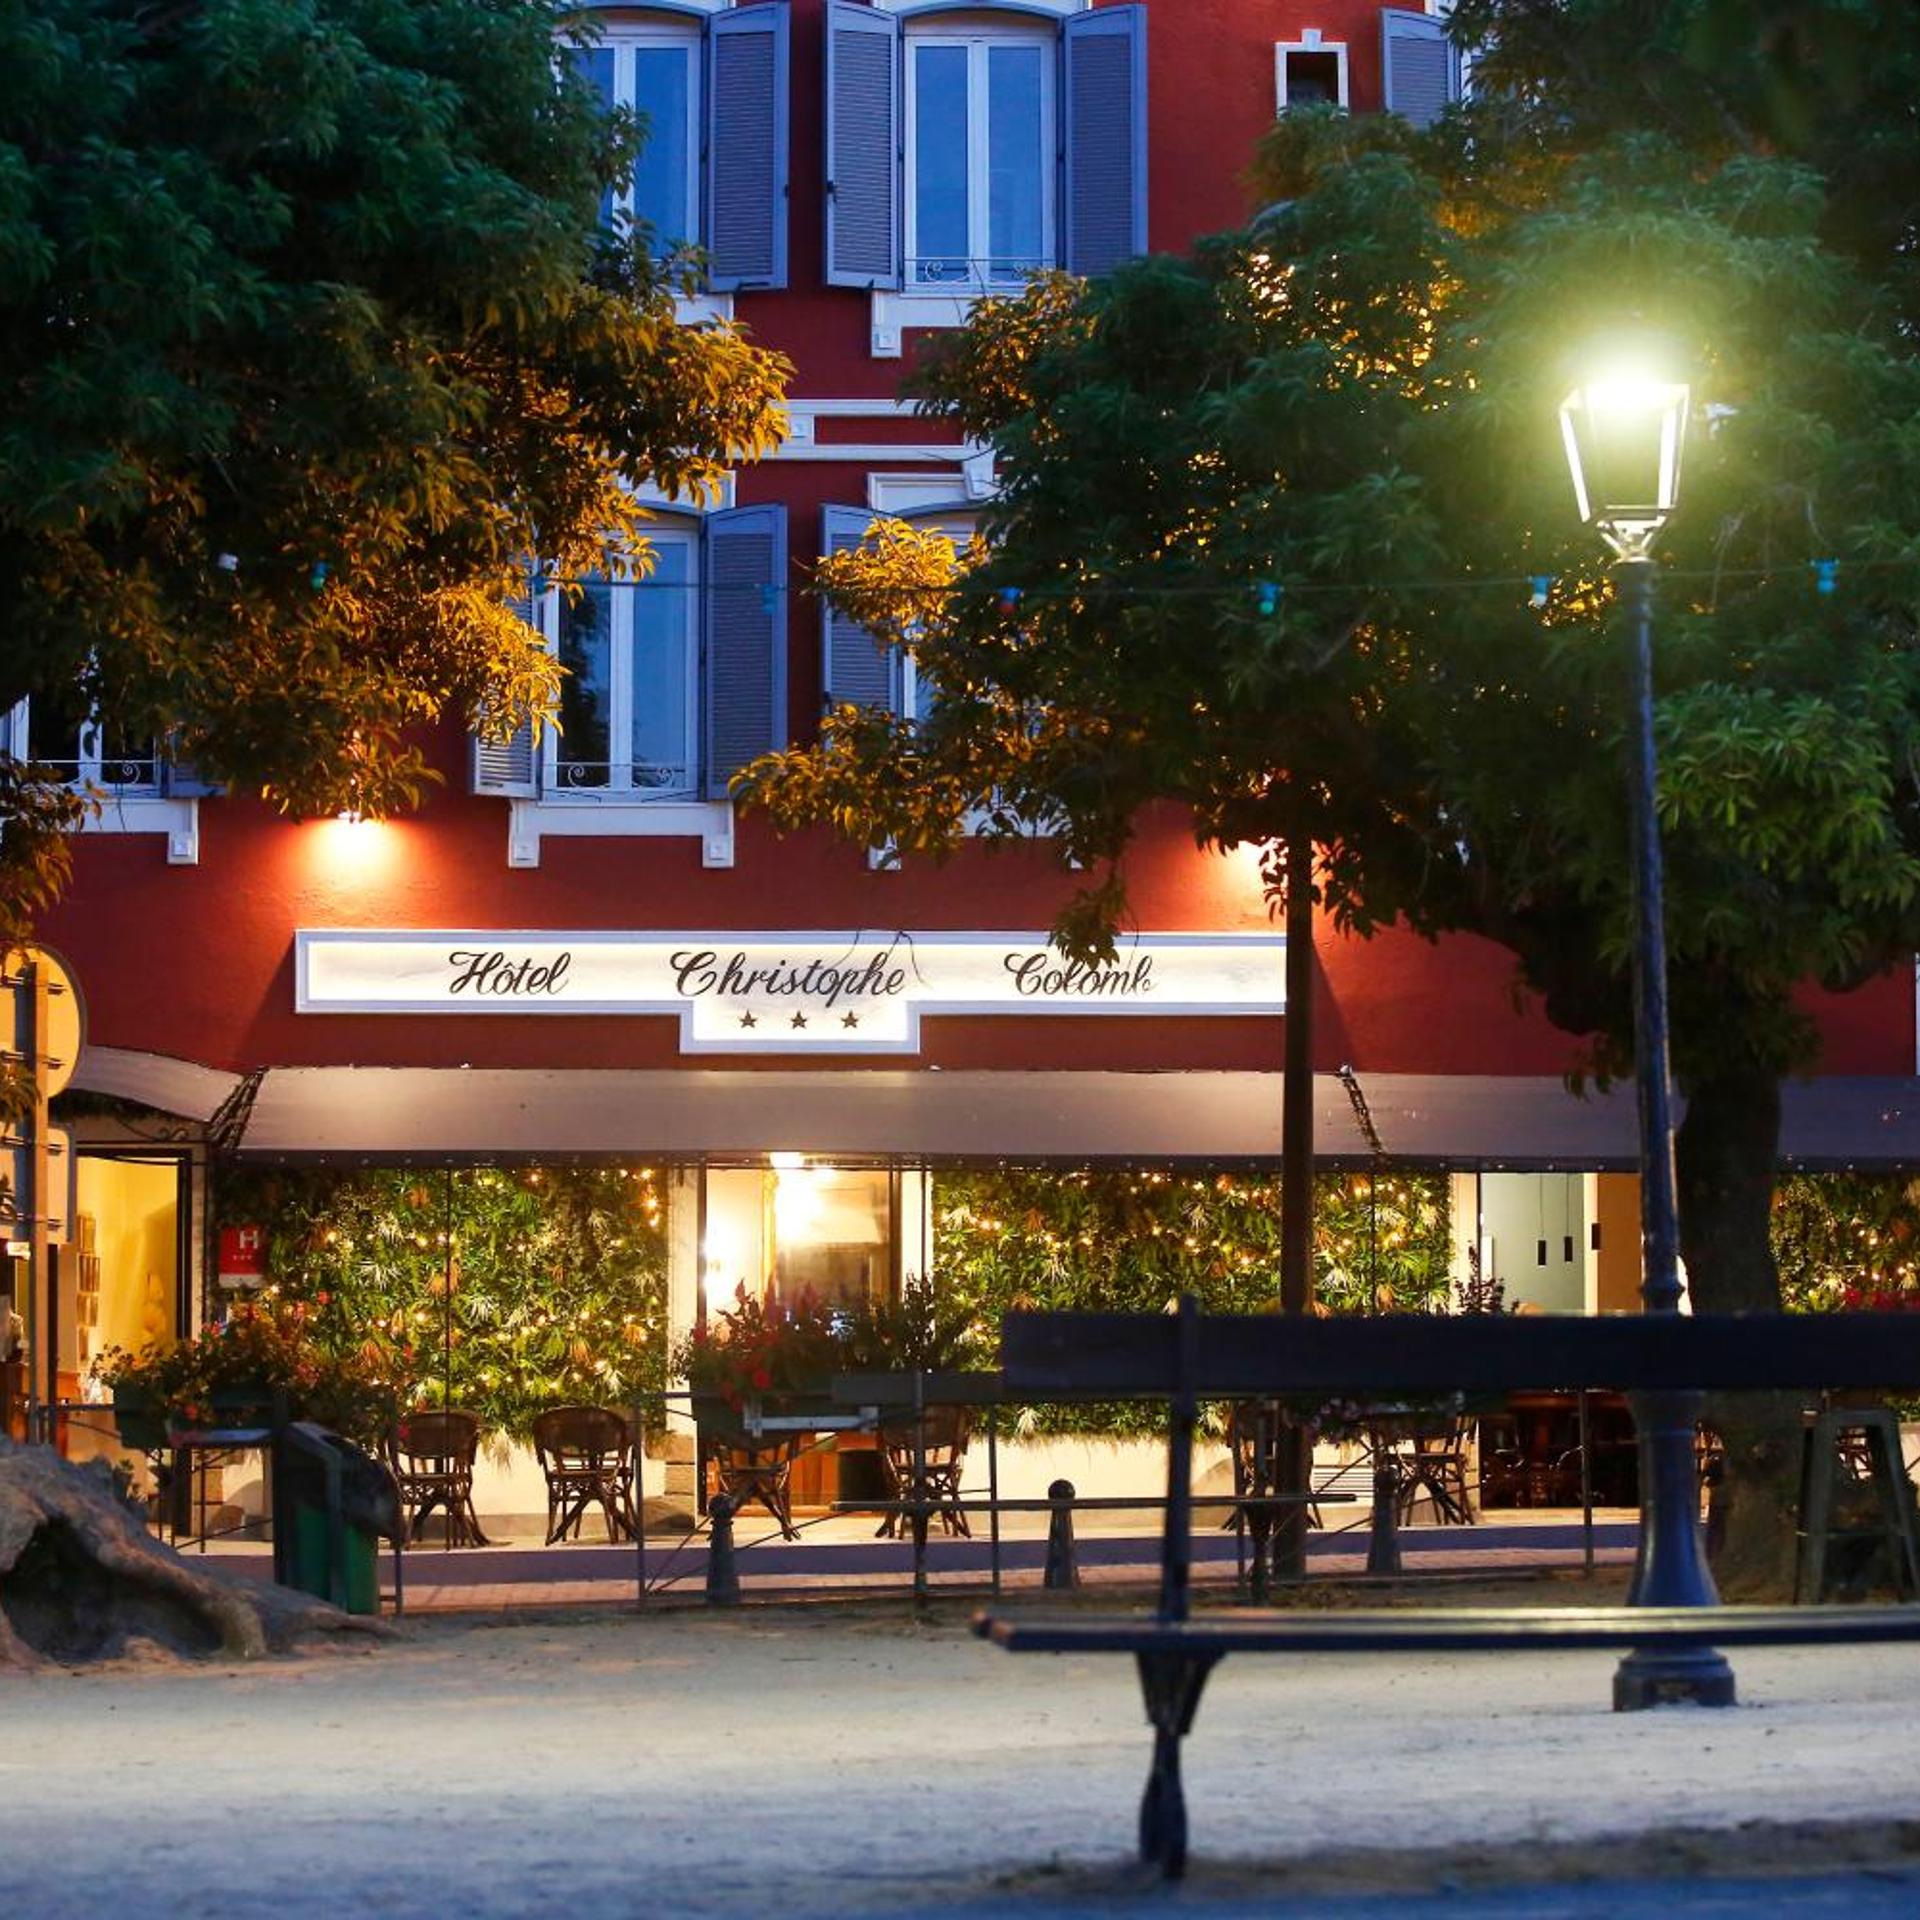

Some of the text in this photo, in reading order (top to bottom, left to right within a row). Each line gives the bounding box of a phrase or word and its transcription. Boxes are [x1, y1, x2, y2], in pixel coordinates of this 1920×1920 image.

[449, 951, 1153, 1008] Hôtel Christophe Colomb
[239, 1230, 259, 1249] H
